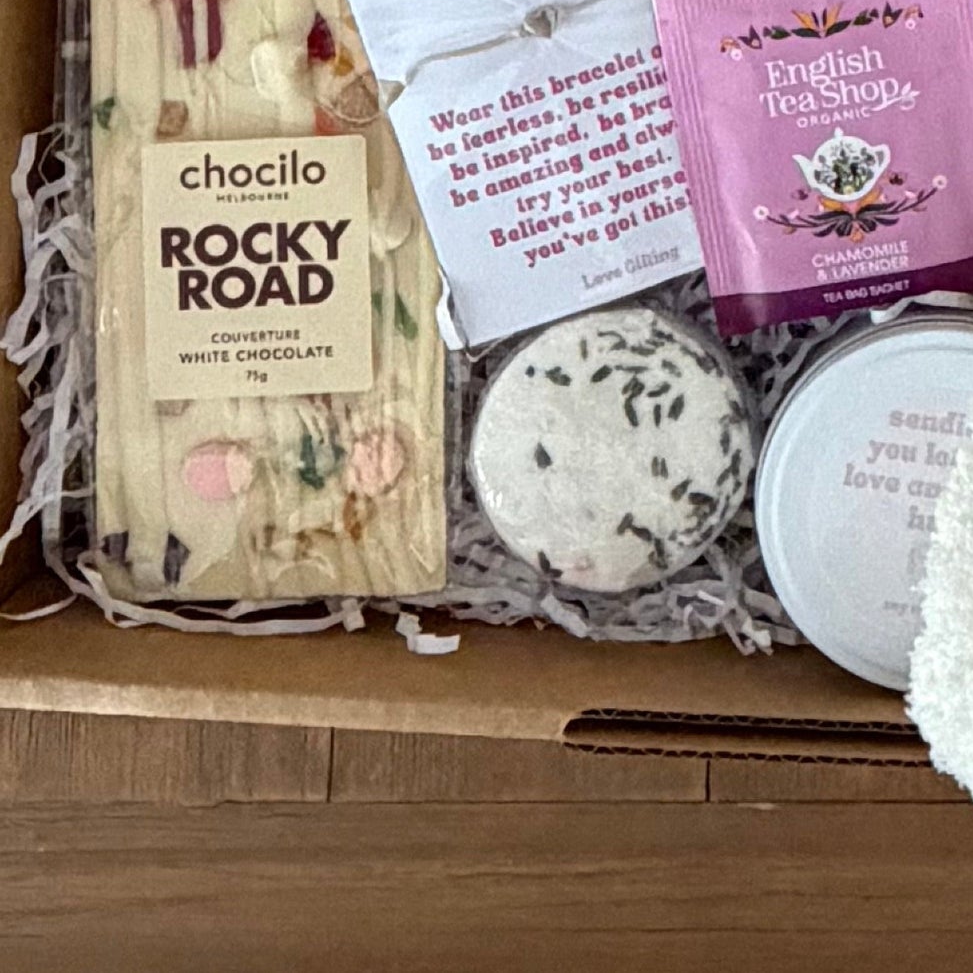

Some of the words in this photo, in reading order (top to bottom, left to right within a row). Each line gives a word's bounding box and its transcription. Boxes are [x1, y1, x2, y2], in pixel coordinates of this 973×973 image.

[765, 45, 885, 89] English
[430, 103, 494, 133] Wear
[499, 85, 546, 112] this
[548, 48, 646, 95] bracelet
[759, 91, 818, 118] Tea
[820, 77, 900, 112] Shop
[427, 143, 457, 161] be
[565, 95, 596, 116] be
[450, 162, 479, 181] be
[597, 111, 626, 132] be
[629, 94, 673, 121] bra
[796, 106, 872, 128] ORGANIC
[180, 149, 327, 191] chocilo
[450, 187, 480, 207] be
[485, 154, 583, 196] amazing
[588, 132, 630, 161] and
[516, 190, 552, 213] try
[558, 170, 611, 204] your
[615, 148, 672, 179] best.
[216, 192, 289, 204] MELBOURNE
[160, 219, 352, 268] ROCKY
[490, 209, 575, 248] Believe
[577, 199, 604, 219] in
[523, 229, 600, 268] you've
[604, 211, 639, 241] got
[811, 240, 909, 268] CHAMOMILE
[816, 269, 828, 281] &
[833, 256, 909, 280] LAVENDER
[178, 264, 335, 312] ROAD
[823, 291, 844, 304] TEA
[179, 350, 231, 364] WHITE
[235, 346, 334, 362] CHOCOLATE
[211, 329, 301, 344] COUVERTURE
[866, 439, 916, 464] you
[843, 463, 900, 493] love
